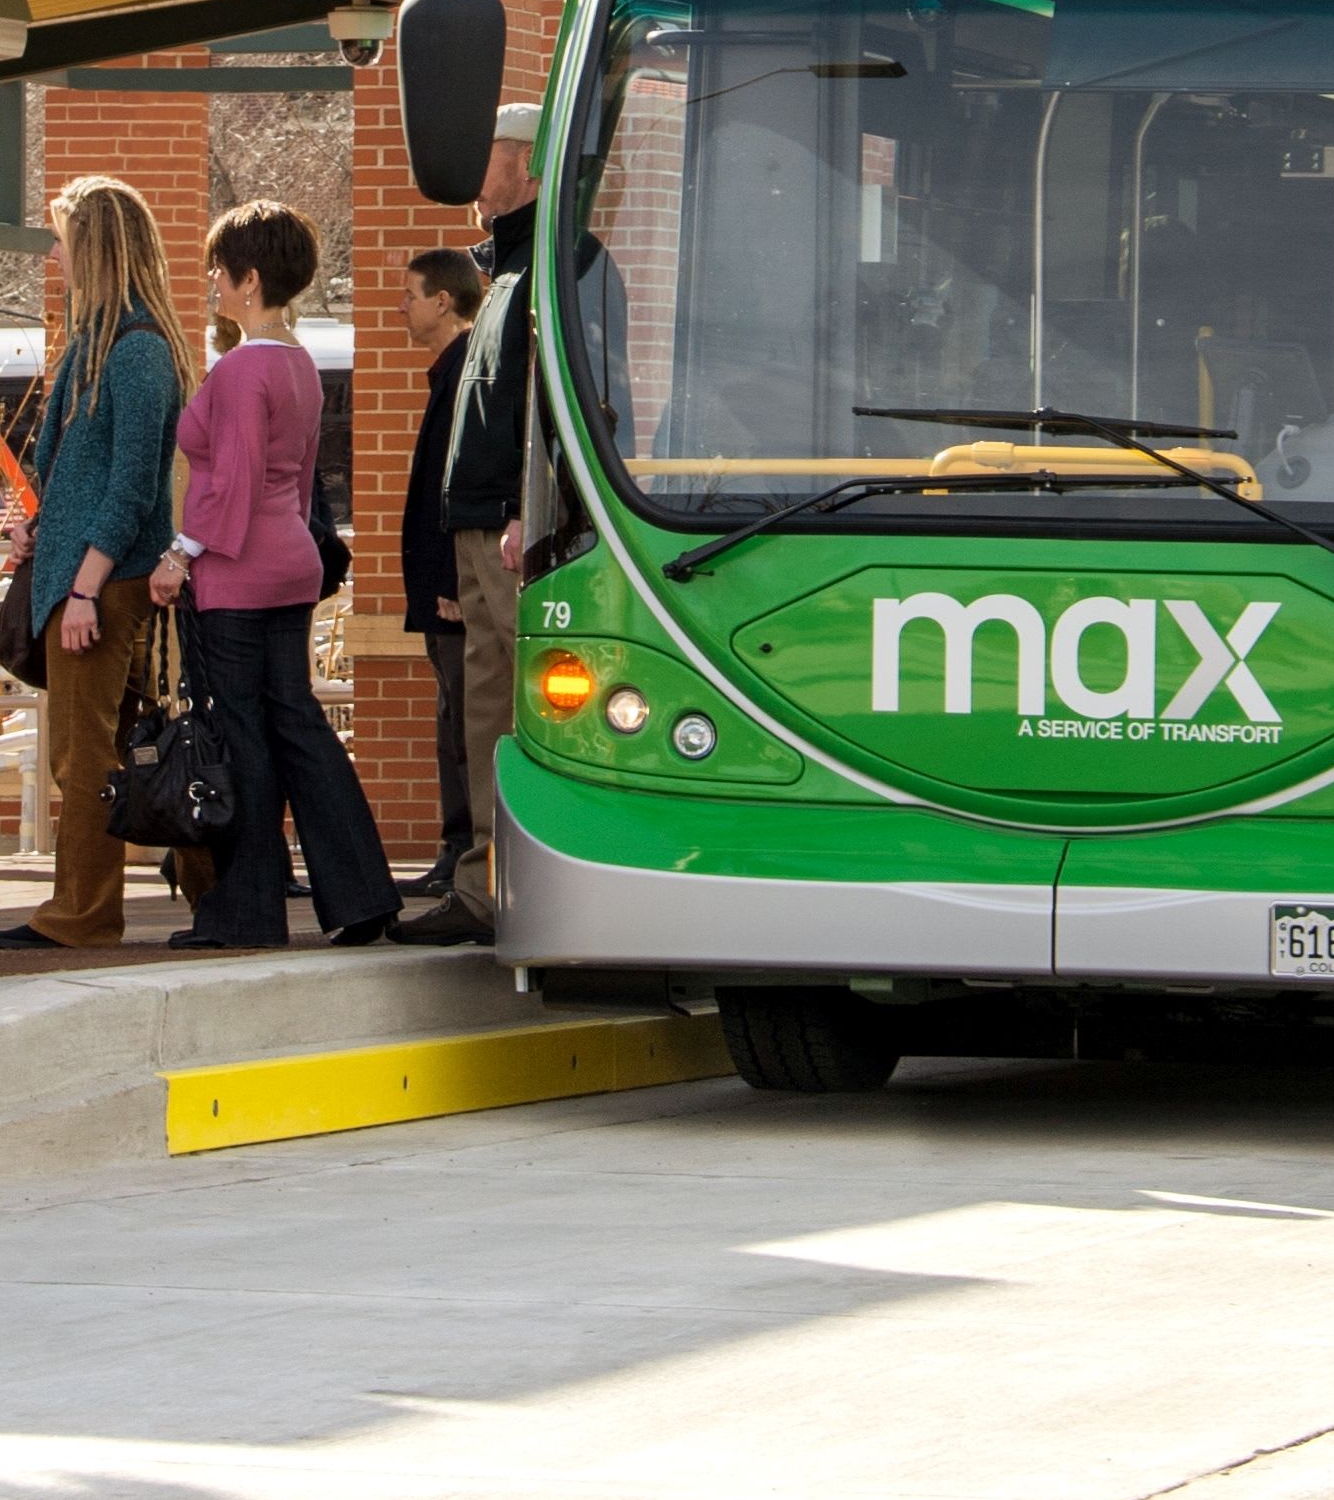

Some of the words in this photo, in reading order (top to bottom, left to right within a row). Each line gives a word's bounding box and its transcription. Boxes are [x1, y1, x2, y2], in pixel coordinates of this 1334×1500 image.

[542, 601, 571, 629] 79
[872, 592, 1283, 722] max
[1018, 719, 1033, 737] A
[1037, 719, 1124, 740] SERVICE
[1127, 722, 1156, 740] OF
[1159, 723, 1283, 744] TRANSFORT
